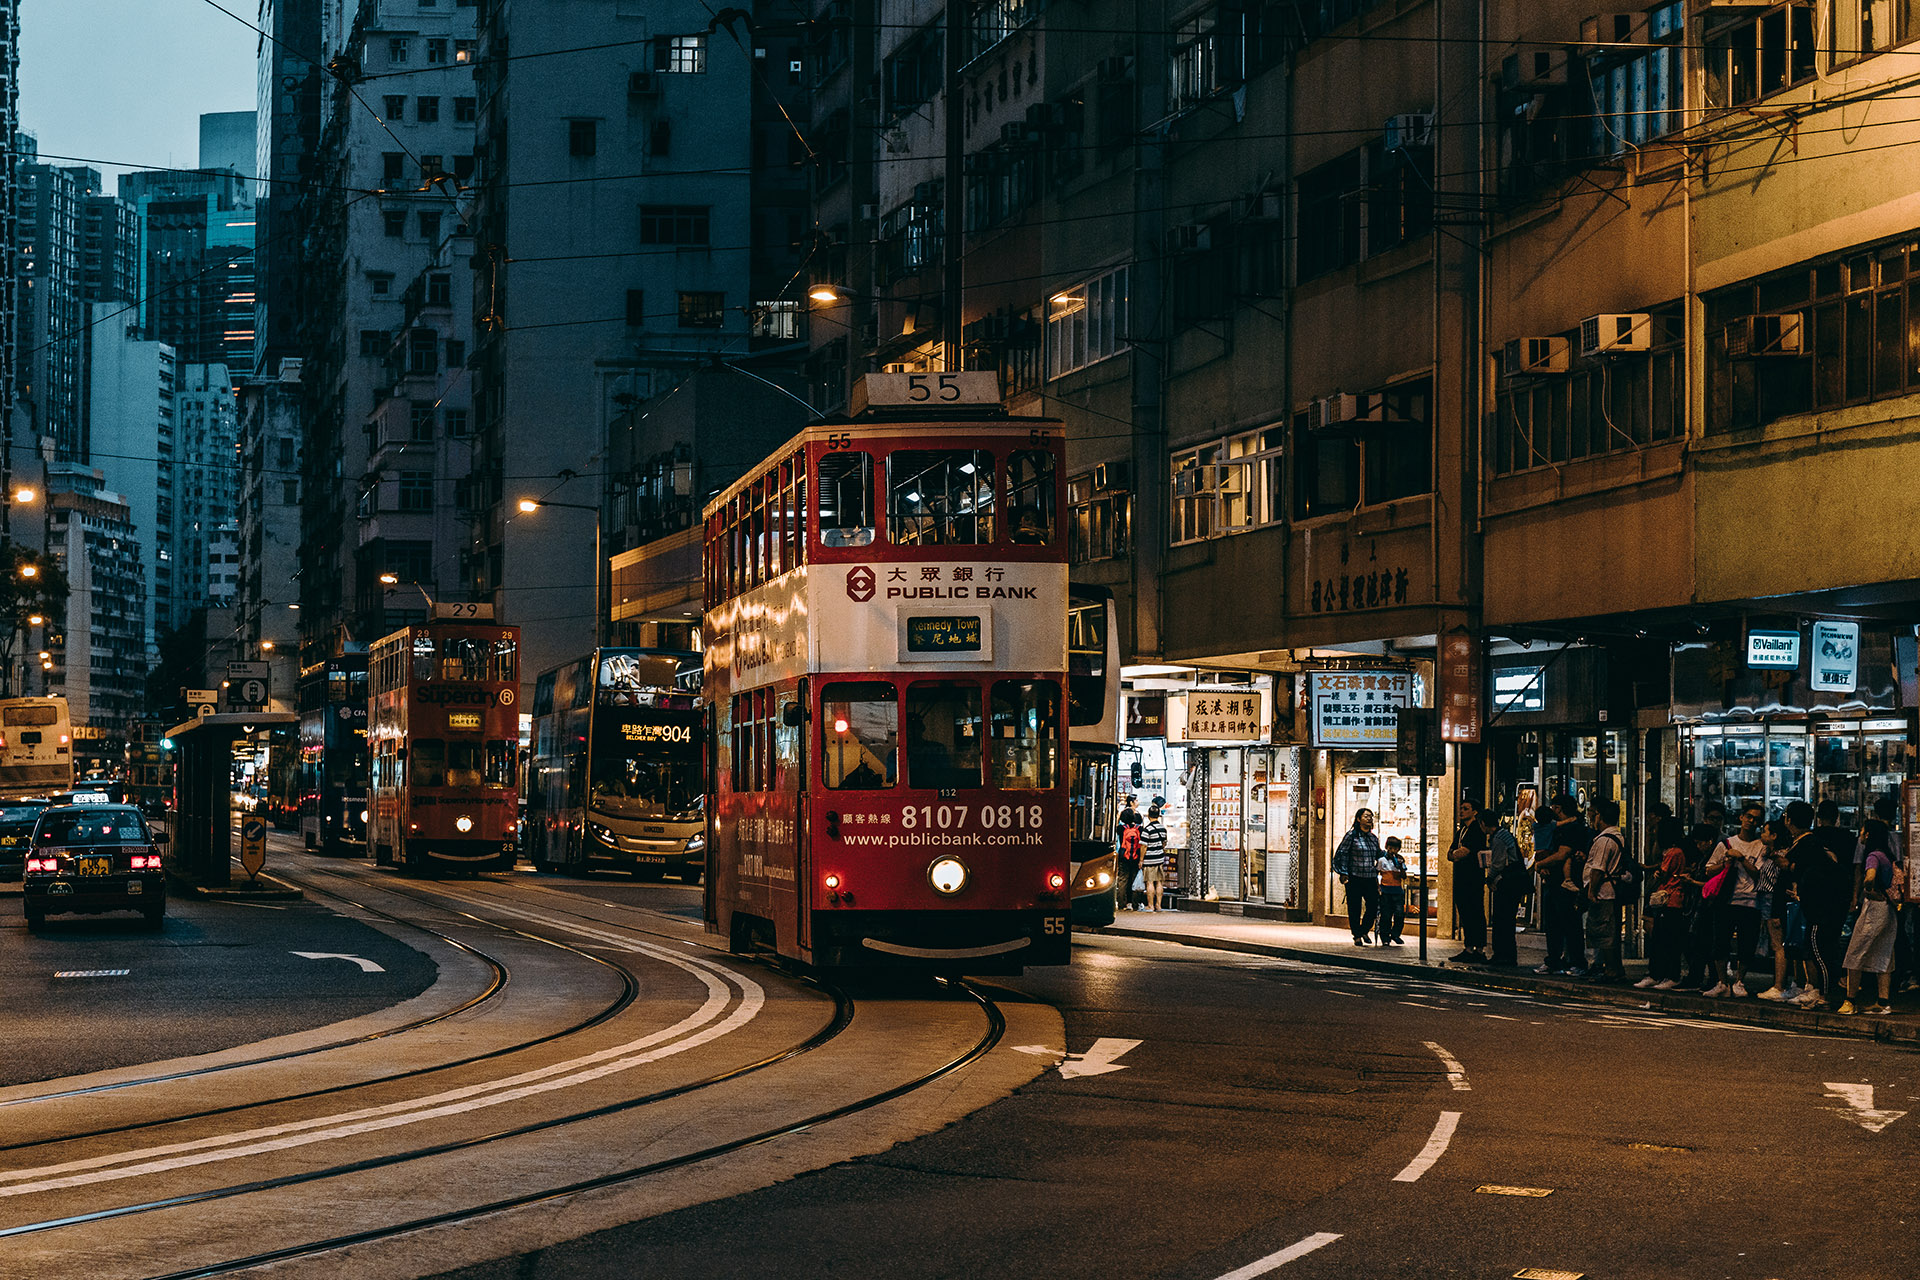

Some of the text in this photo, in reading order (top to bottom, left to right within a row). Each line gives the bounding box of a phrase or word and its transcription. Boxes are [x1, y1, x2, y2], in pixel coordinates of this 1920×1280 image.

[909, 375, 960, 401] 55
[829, 433, 851, 450] 55
[1031, 429, 1050, 446] 55
[887, 587, 1038, 599] PUBLIC BANK
[453, 604, 477, 617] 29
[912, 618, 980, 632] Kennedy Town
[417, 629, 430, 639] 29
[502, 631, 513, 640] 29
[1762, 639, 1793, 651] Vaillant
[1318, 675, 1407, 690] 文石珠寶金行
[354, 708, 367, 716] CFA
[662, 725, 692, 743] 904
[941, 788, 957, 797] 132
[902, 805, 968, 829] 8107
[981, 805, 1043, 829] 0818
[502, 842, 515, 852] 29
[844, 833, 1044, 849] www.publicbank.com.hk
[1043, 916, 1065, 936] 55
